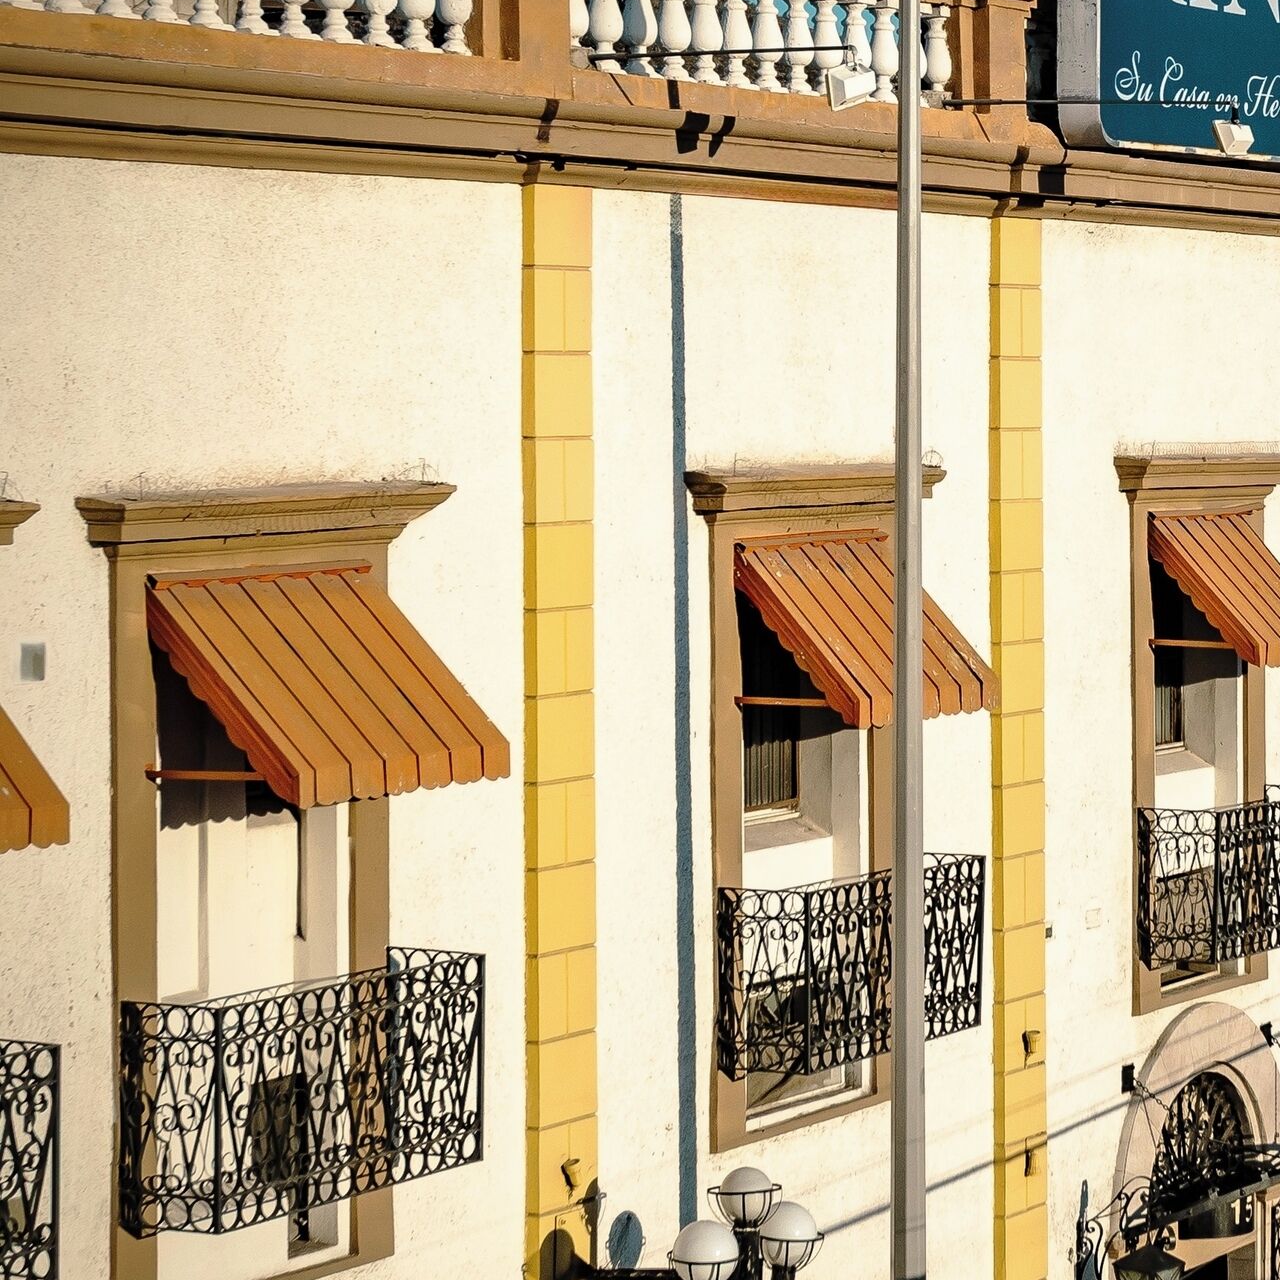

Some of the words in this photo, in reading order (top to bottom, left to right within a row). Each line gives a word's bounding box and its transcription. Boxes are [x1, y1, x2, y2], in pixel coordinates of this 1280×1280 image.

[1114, 50, 1154, 102] Su
[1160, 56, 1212, 110] Casa
[1215, 92, 1240, 113] en
